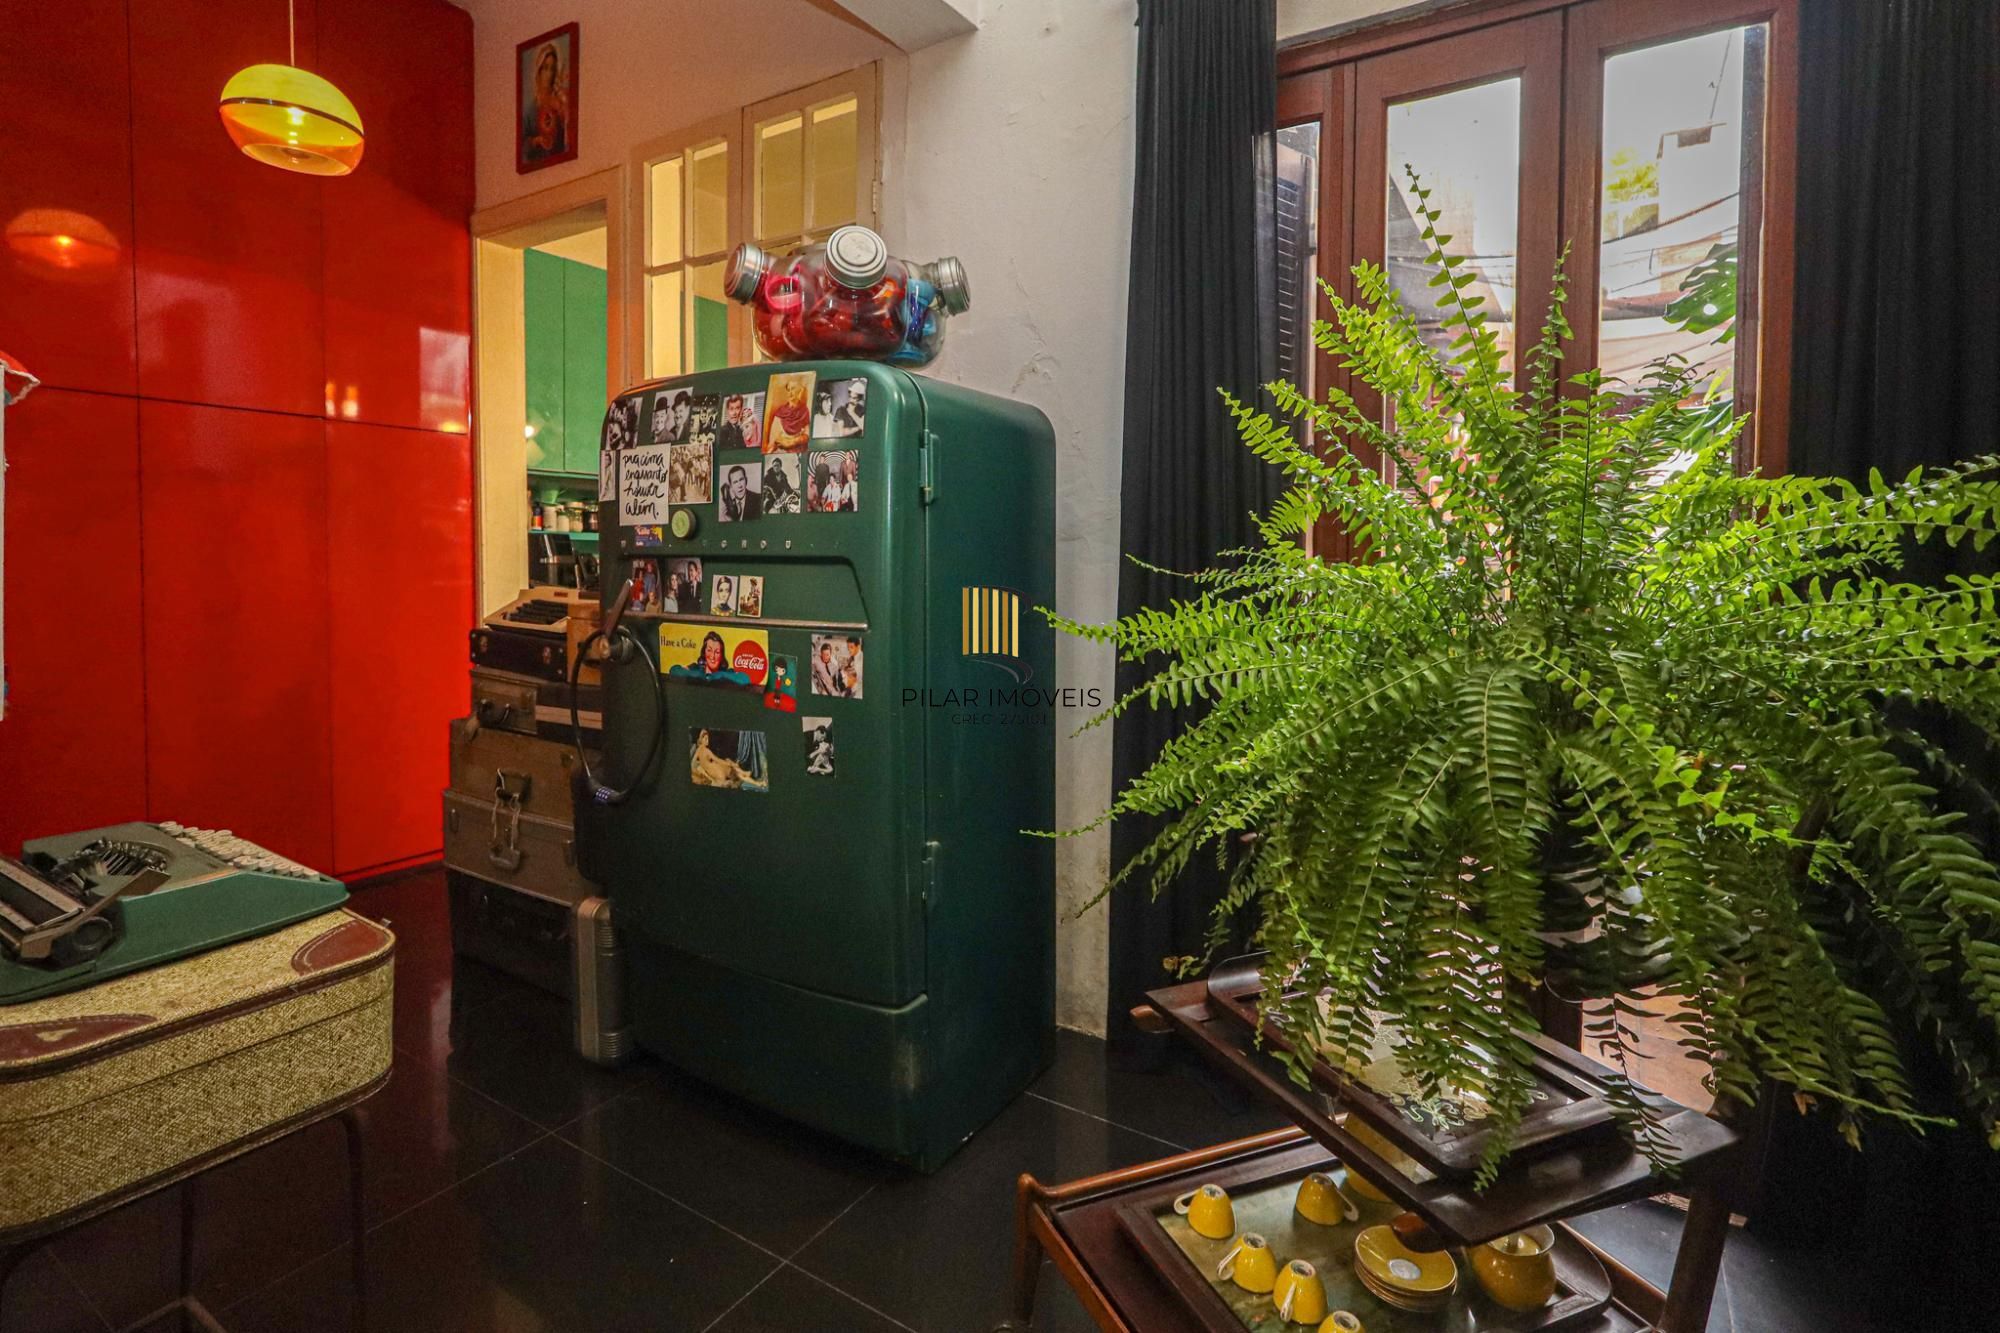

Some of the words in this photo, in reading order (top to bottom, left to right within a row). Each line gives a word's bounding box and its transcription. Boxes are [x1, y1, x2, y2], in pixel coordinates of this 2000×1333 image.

[624, 467, 668, 487] enquanto
[623, 481, 665, 499] houver
[625, 498, 660, 520] além.
[660, 636, 675, 647] Have
[681, 638, 697, 649] Coke
